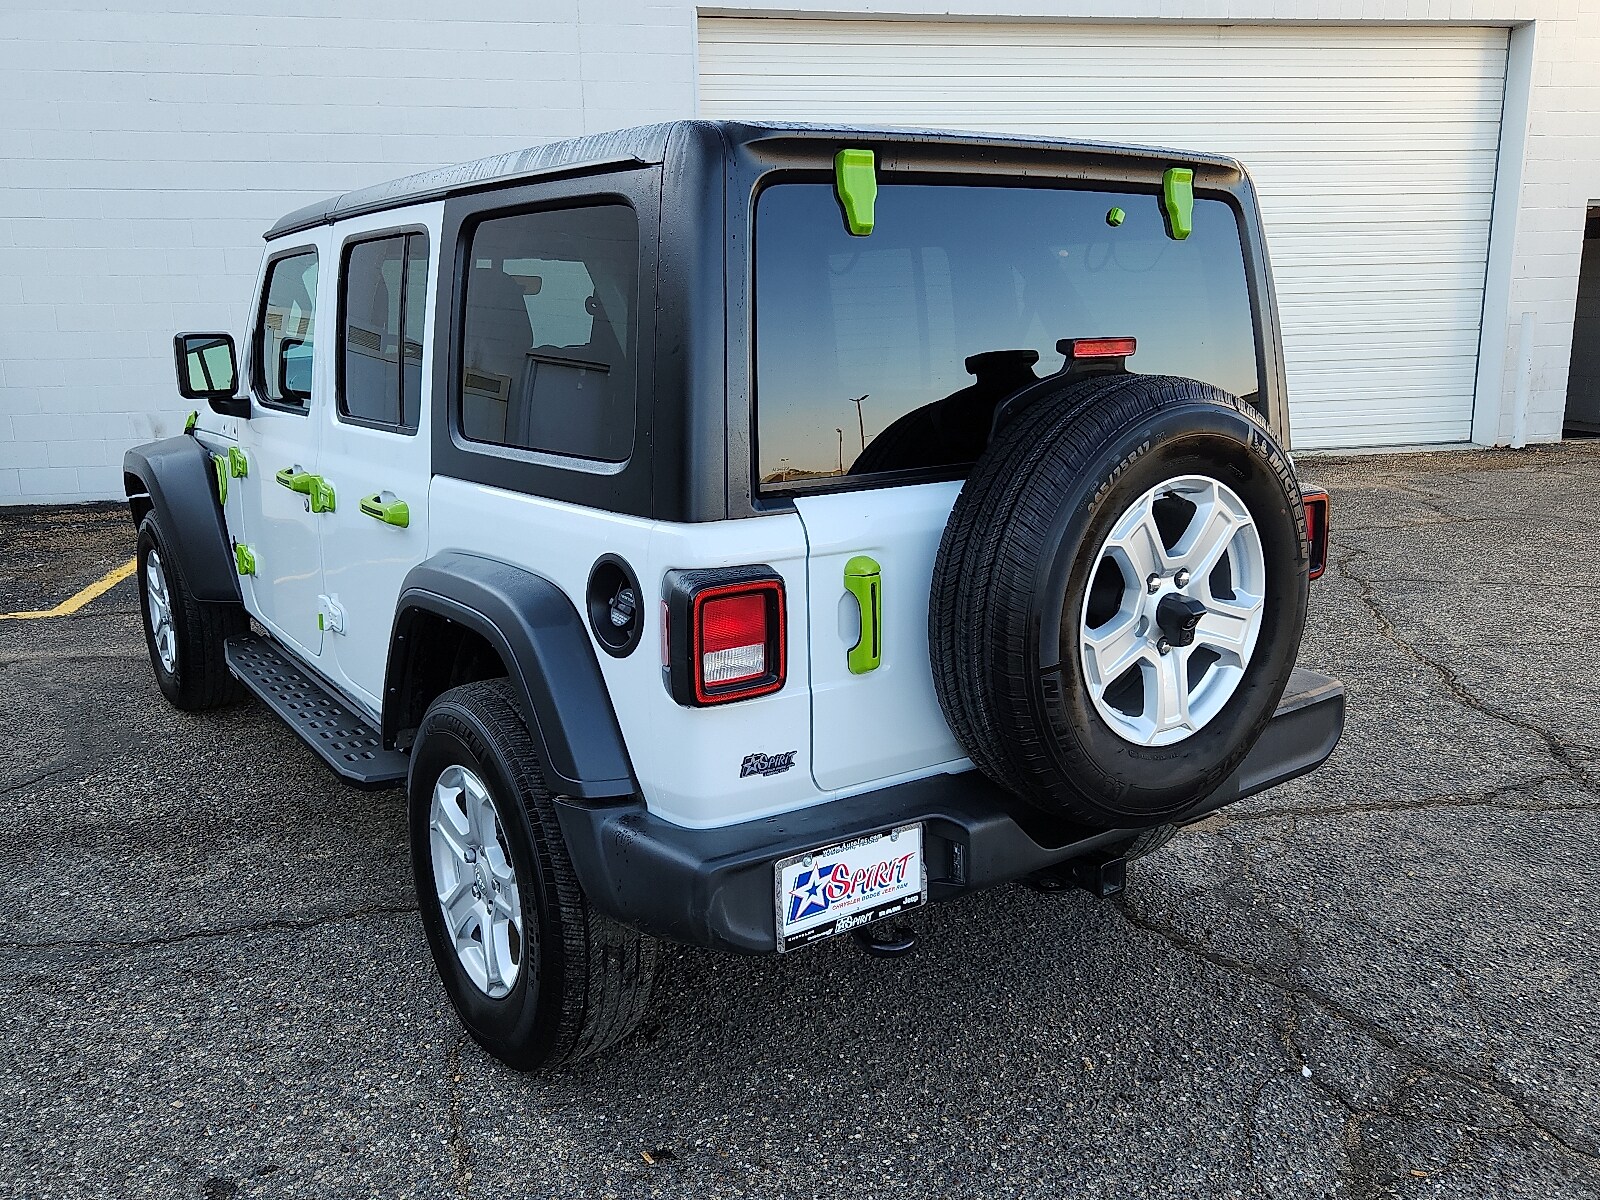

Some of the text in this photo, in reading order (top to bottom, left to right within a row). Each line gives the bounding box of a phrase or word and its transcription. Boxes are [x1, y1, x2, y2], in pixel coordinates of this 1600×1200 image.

[1087, 440, 1151, 515] 245/75R17
[1269, 450, 1310, 560] MICHELIN
[758, 750, 798, 770] SPIRIT
[827, 851, 916, 899] SPIRIT
[831, 897, 861, 911] CHRYSLER
[861, 890, 881, 902] DODGE
[881, 886, 895, 895] JEEP
[846, 911, 875, 928] SPIRIT
[878, 905, 902, 917] RAM
[902, 895, 919, 905] Jeep
